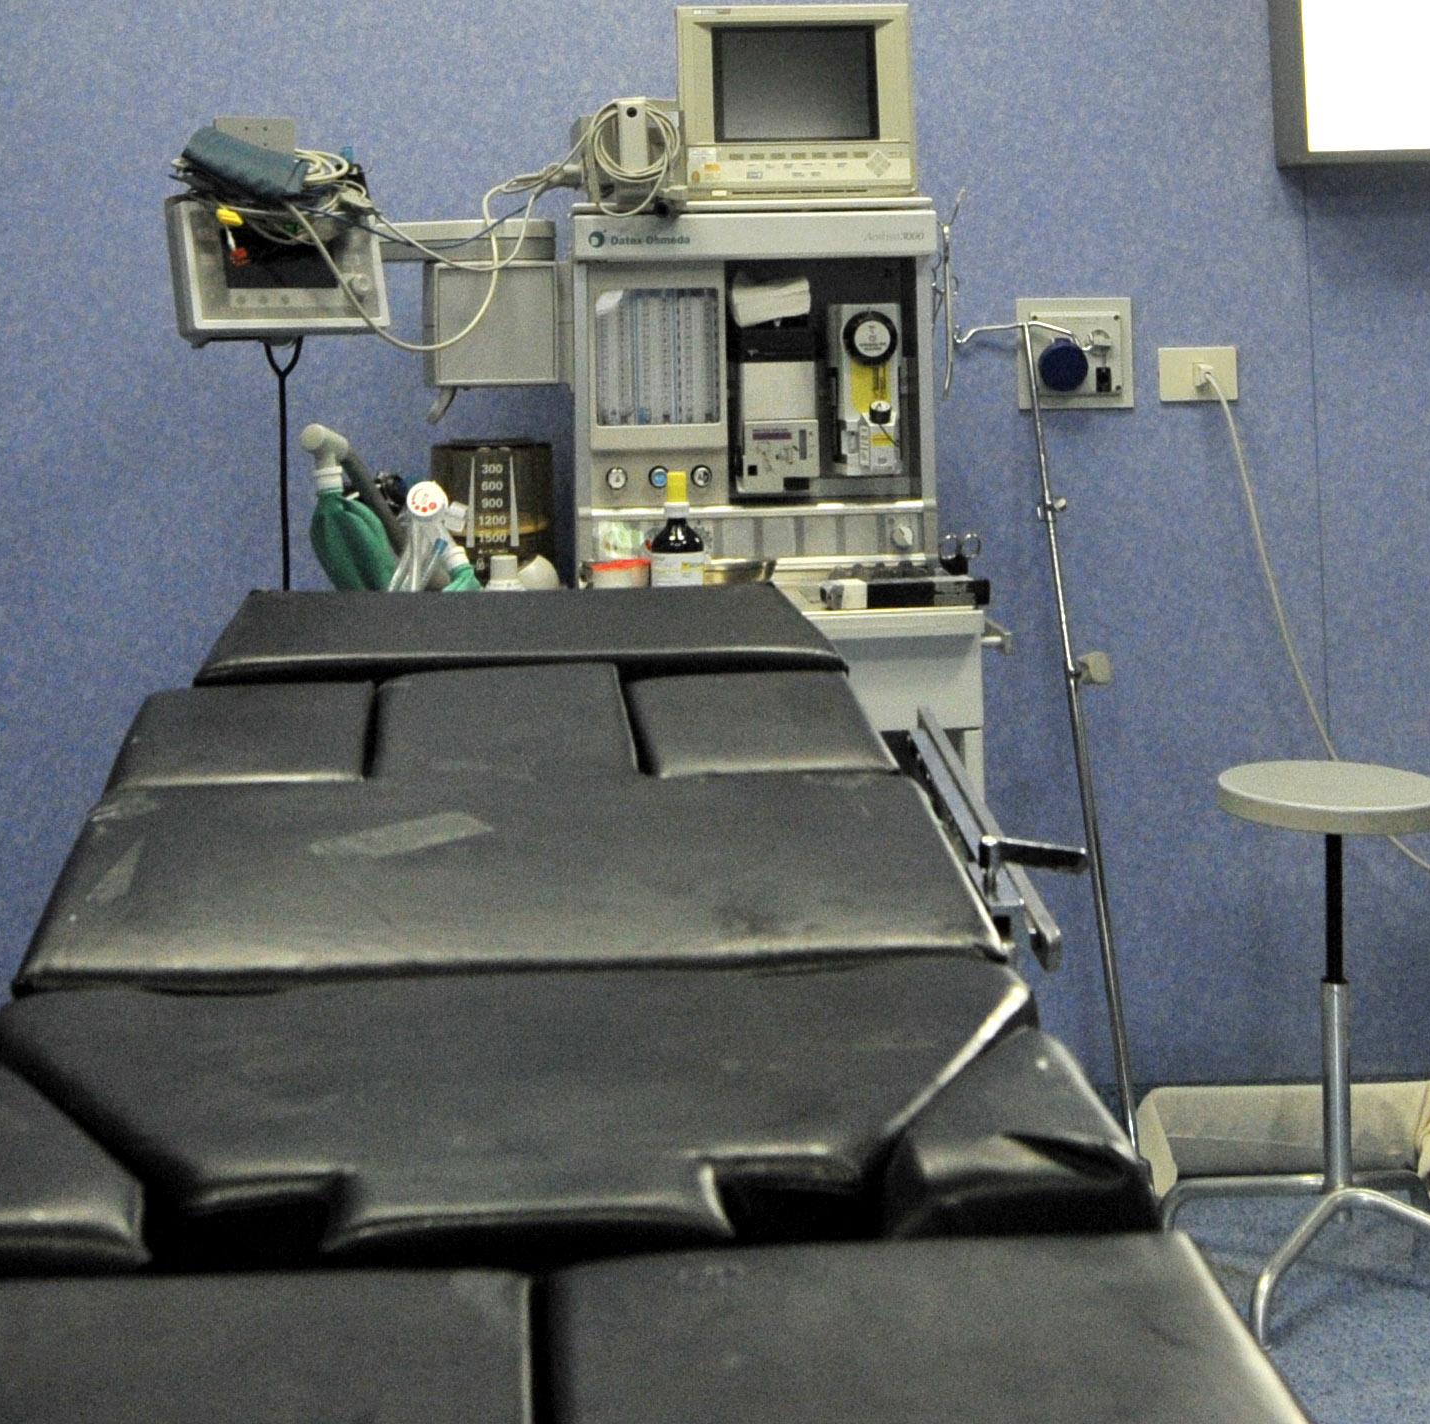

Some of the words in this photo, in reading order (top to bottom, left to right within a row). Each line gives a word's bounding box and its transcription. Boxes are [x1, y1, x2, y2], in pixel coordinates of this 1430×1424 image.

[481, 463, 504, 474] 300
[481, 480, 504, 492] 600
[481, 497, 504, 509] 900
[478, 515, 507, 526] 1200
[478, 532, 507, 544] 1500
